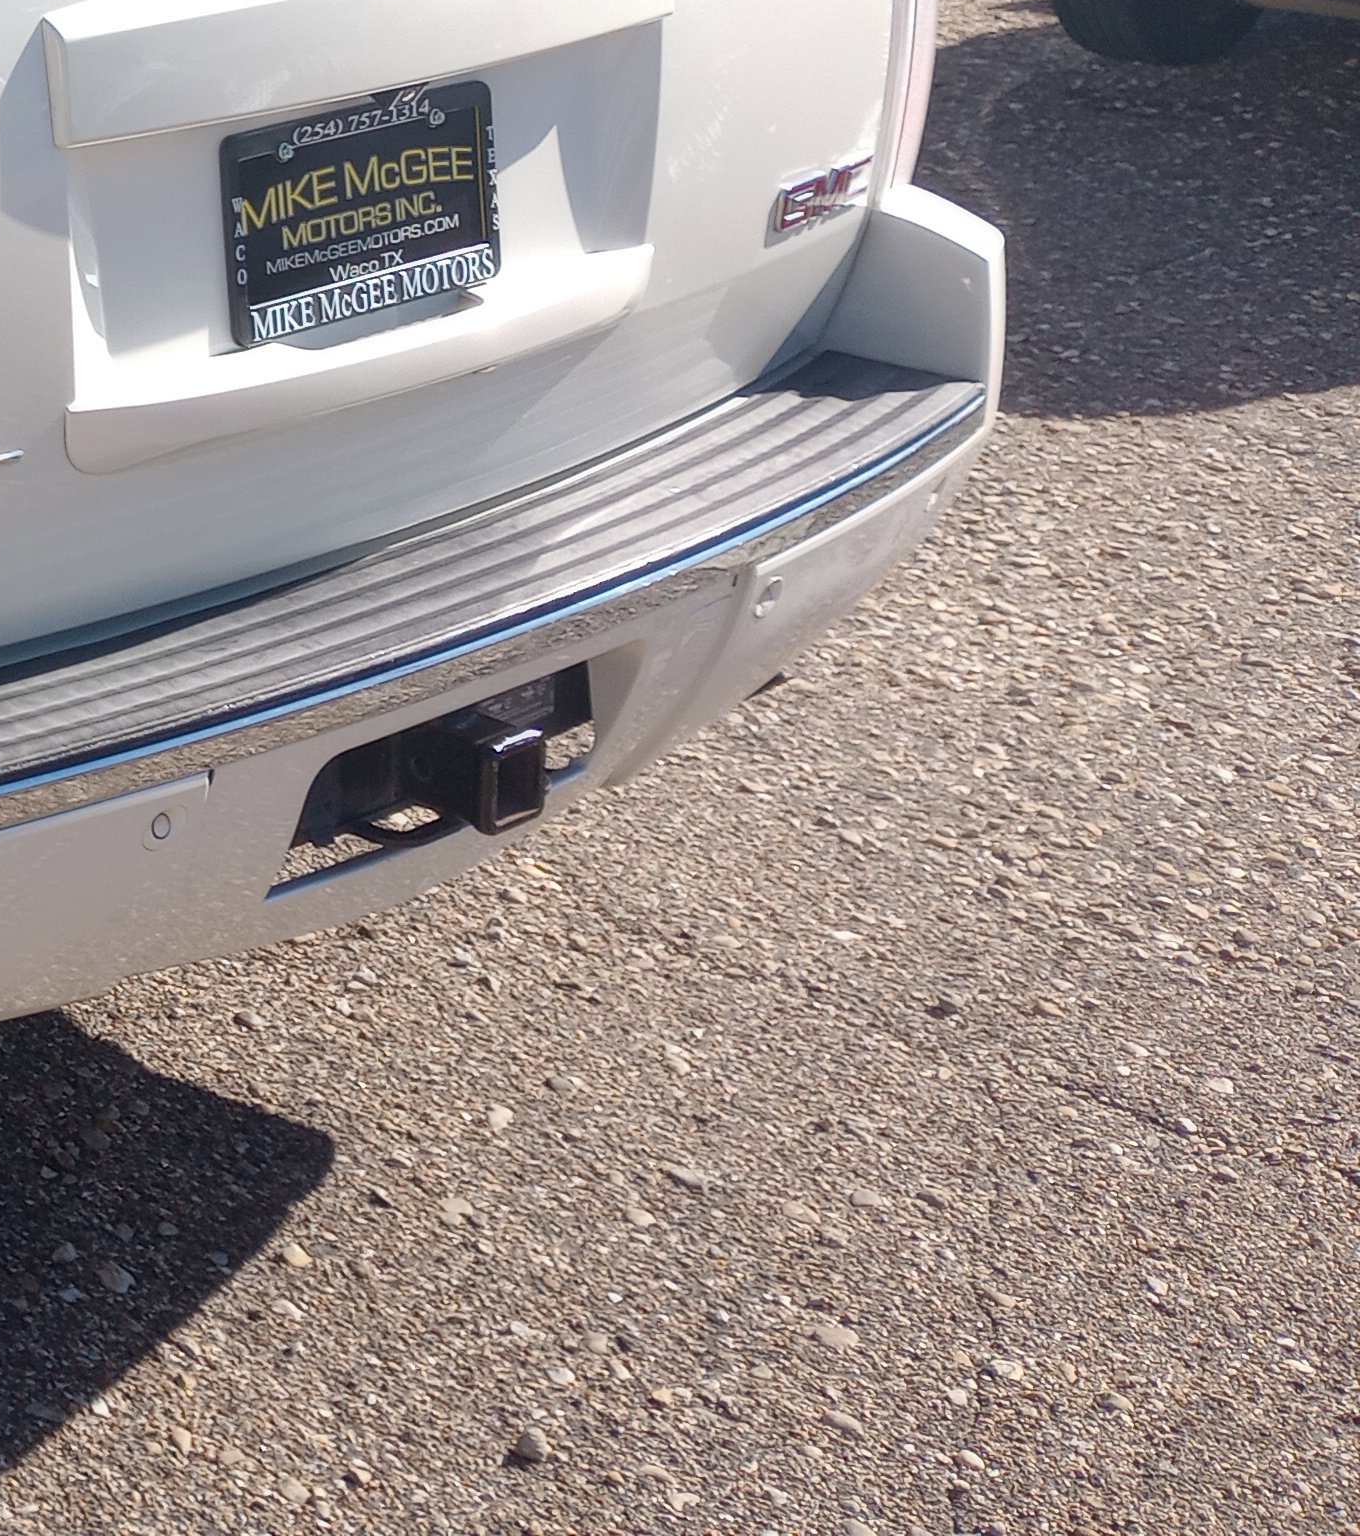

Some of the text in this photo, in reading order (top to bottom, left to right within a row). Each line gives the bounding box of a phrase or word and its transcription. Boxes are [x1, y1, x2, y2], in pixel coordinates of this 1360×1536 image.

[292, 118, 344, 146] (254)
[240, 146, 474, 235] MIKE McGEE
[281, 190, 442, 251] MOTORS INC.
[232, 197, 248, 285] WACO
[329, 248, 405, 282] Waco TX
[250, 249, 495, 342] MIKE McGEE MOTORS
